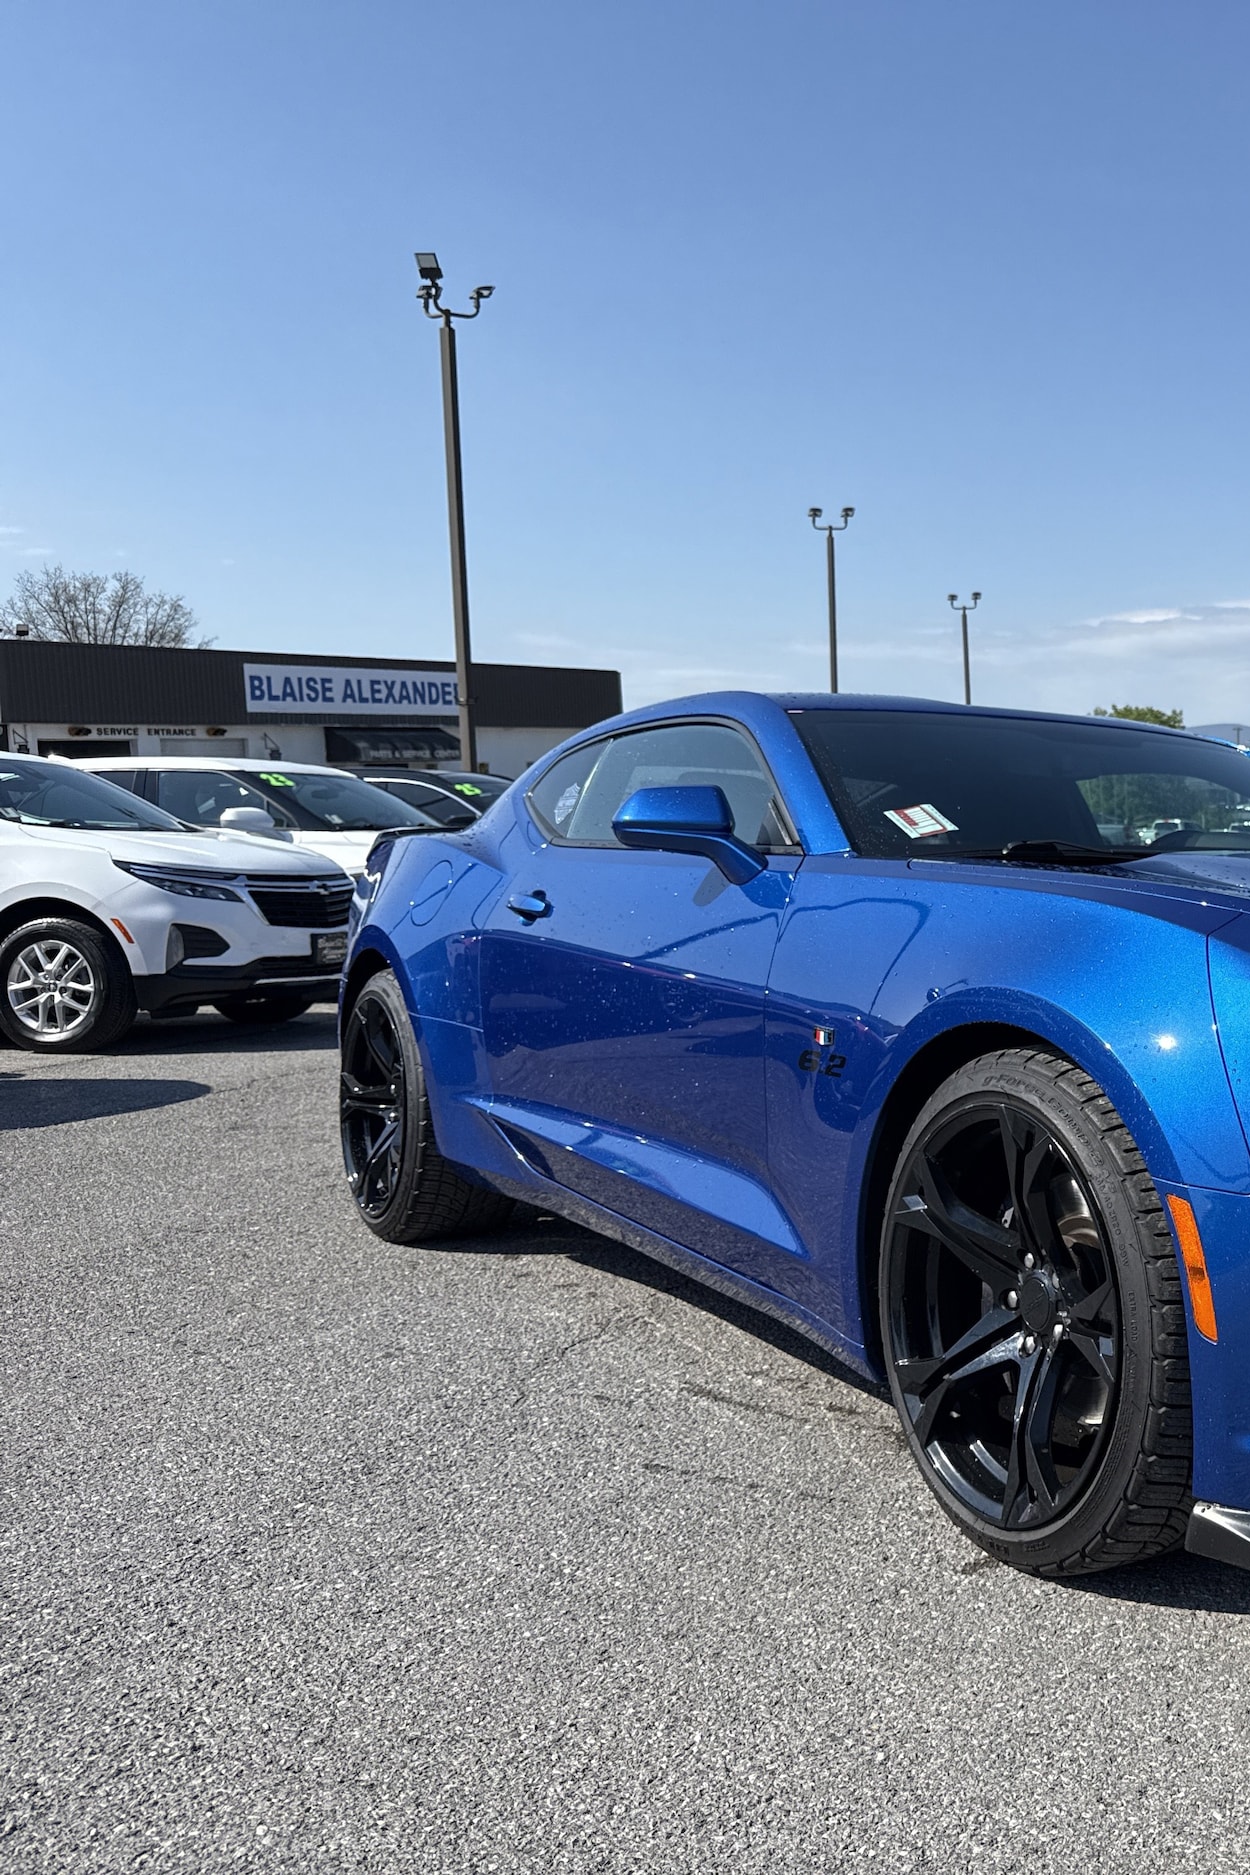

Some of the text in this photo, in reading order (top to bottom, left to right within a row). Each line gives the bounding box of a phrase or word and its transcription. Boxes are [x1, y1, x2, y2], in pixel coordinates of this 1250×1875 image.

[249, 675, 334, 703] BLAISE
[96, 727, 197, 737] SERVICE ENTRANCE
[798, 1049, 847, 1078] 6.2
